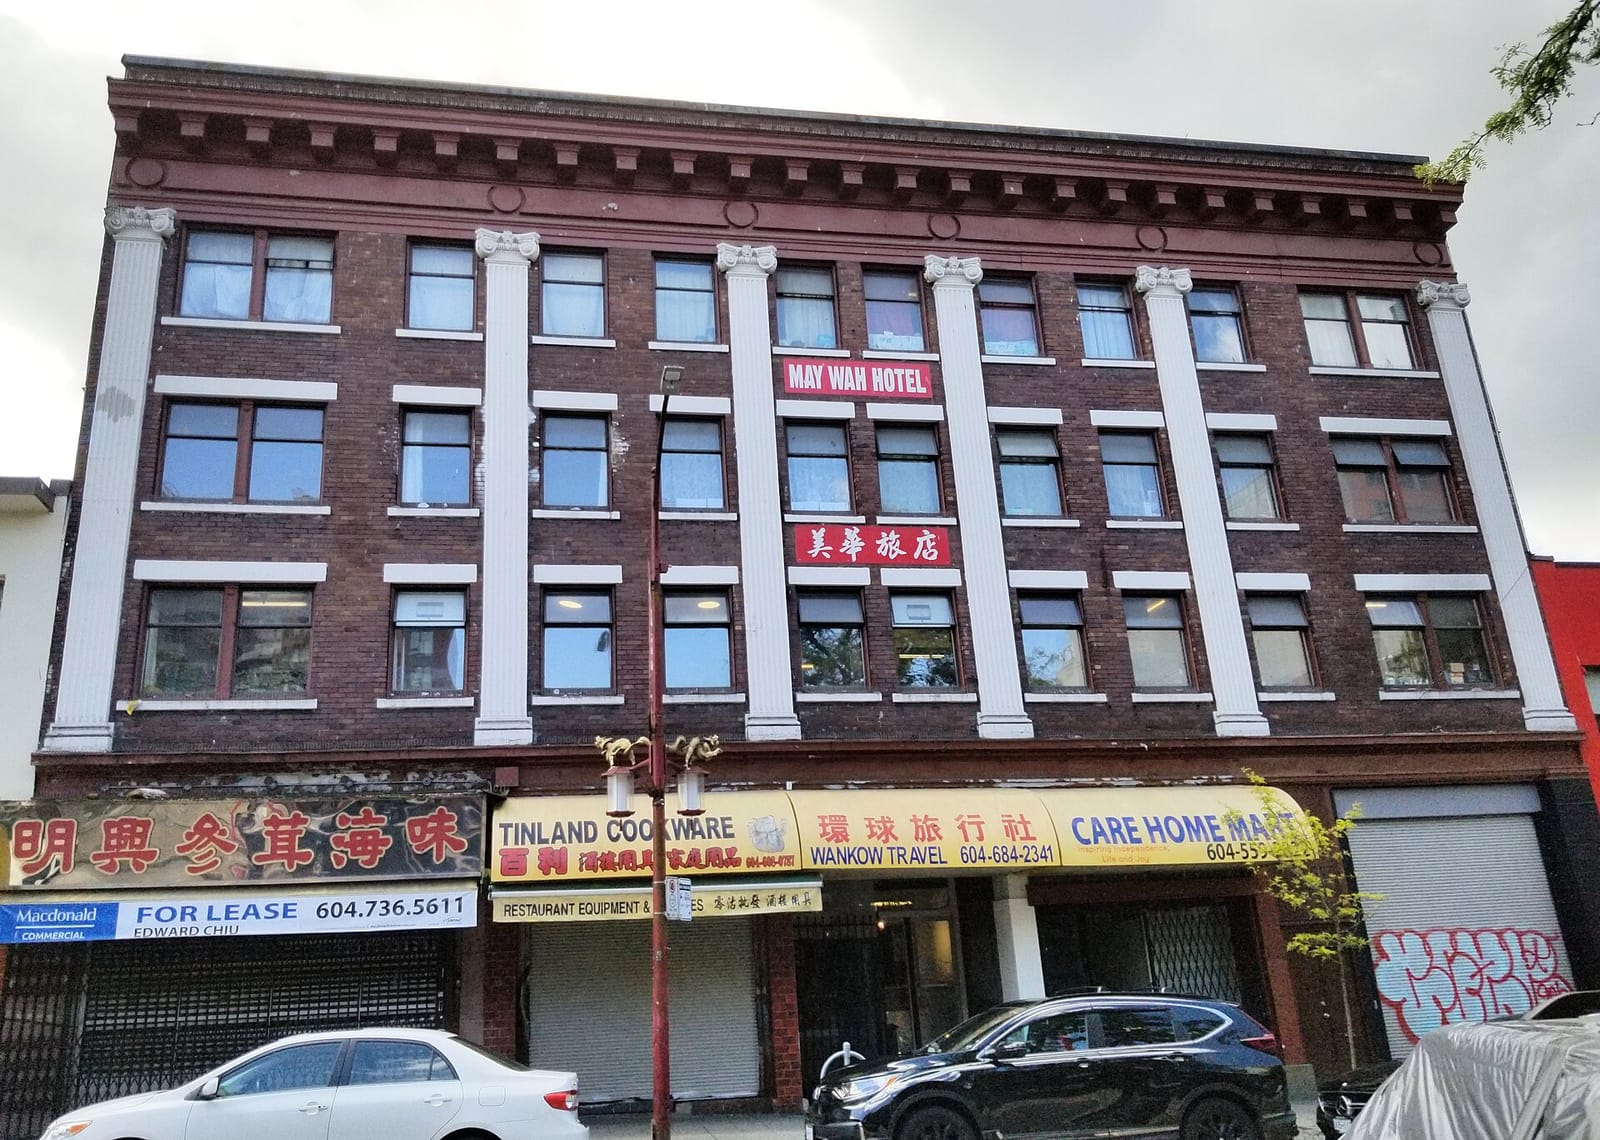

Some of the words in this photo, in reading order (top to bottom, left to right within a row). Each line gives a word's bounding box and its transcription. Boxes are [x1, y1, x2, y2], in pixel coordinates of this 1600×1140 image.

[788, 364, 823, 390] MAY
[827, 365, 867, 392] WAH
[872, 367, 927, 393] HOTEL
[807, 526, 943, 562] 美華旅店
[499, 821, 598, 846] TINLAND
[817, 814, 1037, 844] 環球旅行社
[1071, 816, 1142, 845] CARE
[1142, 815, 1226, 844] HOME
[498, 846, 568, 877] 百利
[810, 846, 883, 866] WANKOW
[887, 846, 948, 865] TRAVEL
[960, 844, 1054, 864] 604-684-2341
[16, 907, 97, 923] Macdonald
[136, 906, 198, 924] FOR
[206, 902, 298, 922] LEASE
[316, 896, 464, 919] 604.736.5611
[503, 904, 576, 917] RESTAURANT
[578, 901, 640, 914] EQUIPMENT
[643, 900, 651, 913] &
[22, 931, 85, 940] COMMERCIAL
[134, 926, 200, 938] EDWARD
[203, 925, 239, 936] CHIU
